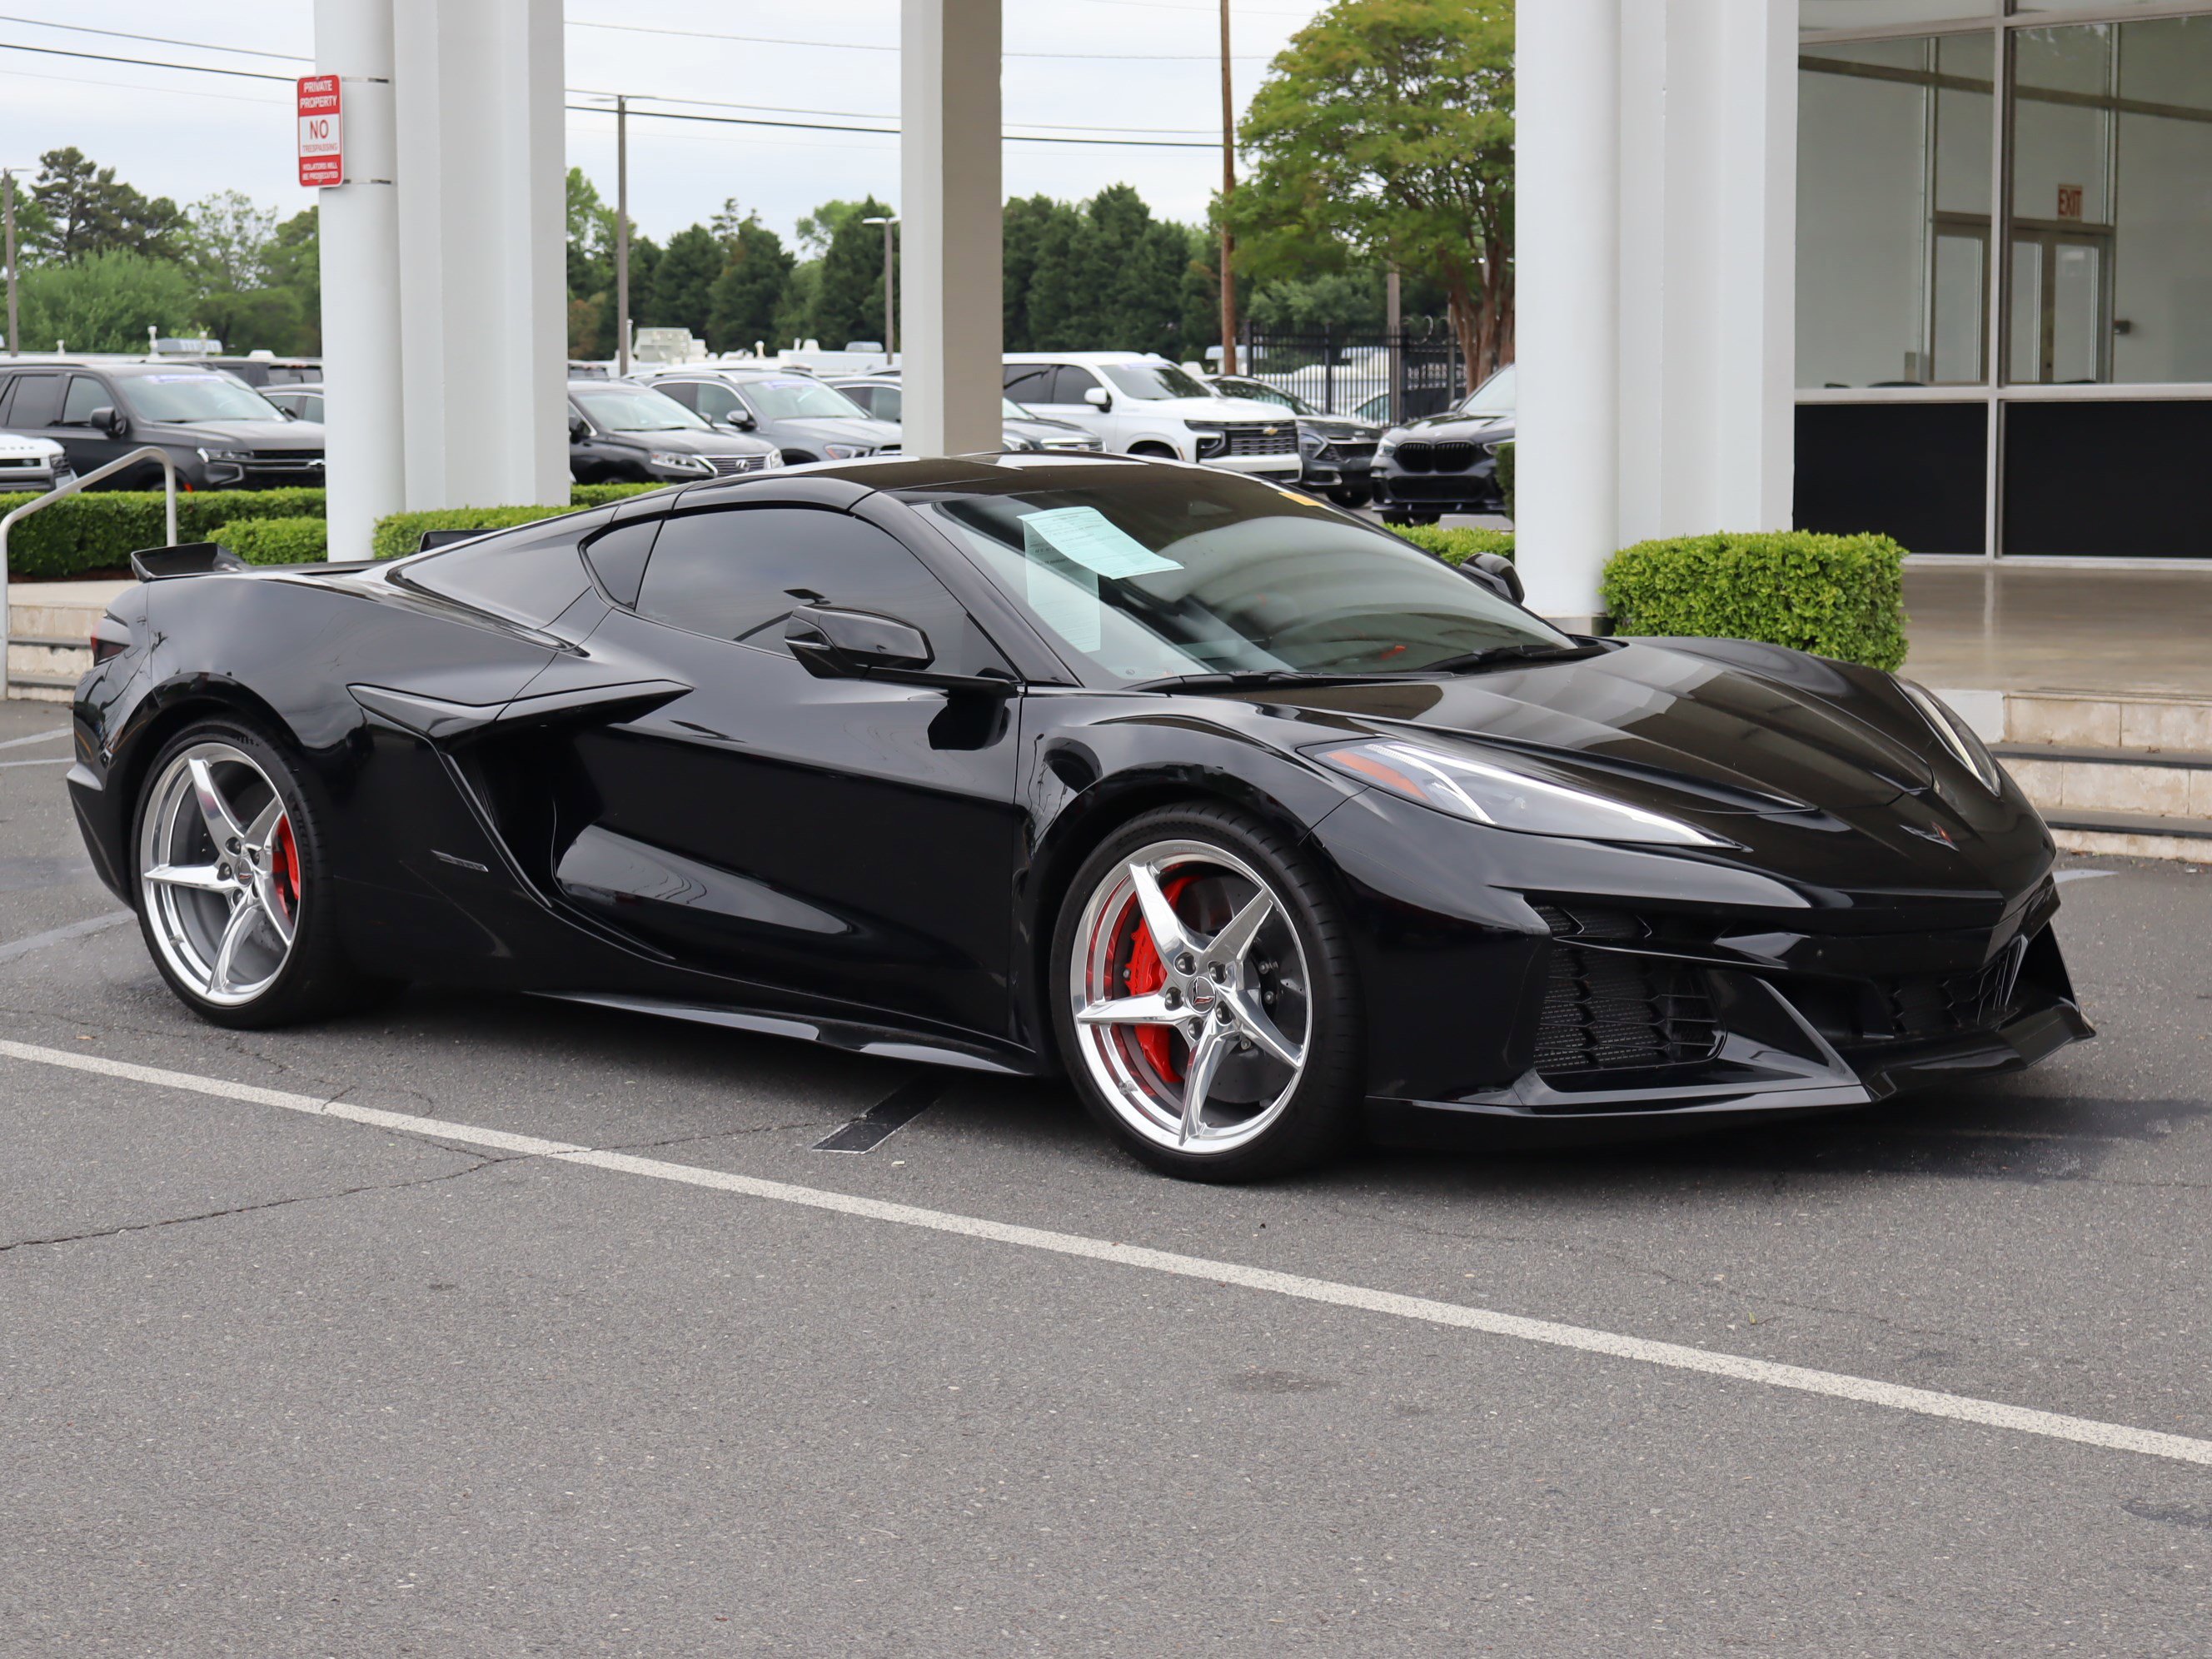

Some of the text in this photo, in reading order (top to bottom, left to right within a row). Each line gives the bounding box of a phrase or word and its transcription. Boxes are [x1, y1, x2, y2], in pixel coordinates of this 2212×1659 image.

[303, 80, 332, 93] PRIVATE
[300, 95, 337, 108] PROPERTY
[310, 119, 329, 139] NO
[2058, 189, 2081, 217] EXIT
